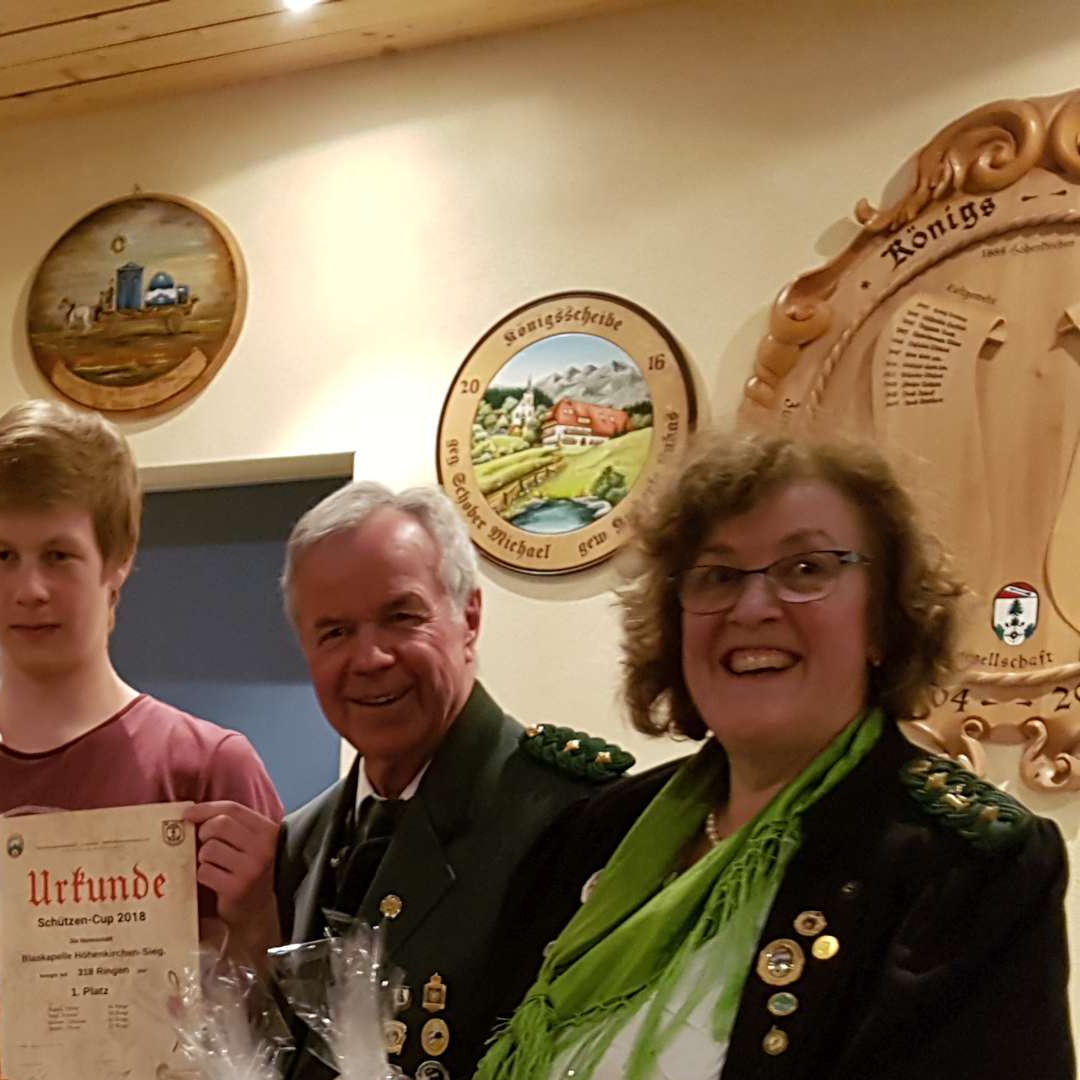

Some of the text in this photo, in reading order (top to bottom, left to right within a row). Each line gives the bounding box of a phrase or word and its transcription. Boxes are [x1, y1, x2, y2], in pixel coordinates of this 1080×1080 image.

[879, 197, 997, 271] Königs
[460, 353, 666, 395] 20 16
[487, 525, 552, 561] Michael
[27, 863, 166, 906] Urkunde
[37, 911, 147, 928] Schützen-Cup 2018
[96, 966, 130, 977] Ringen
[71, 986, 109, 996] 1. Platz
